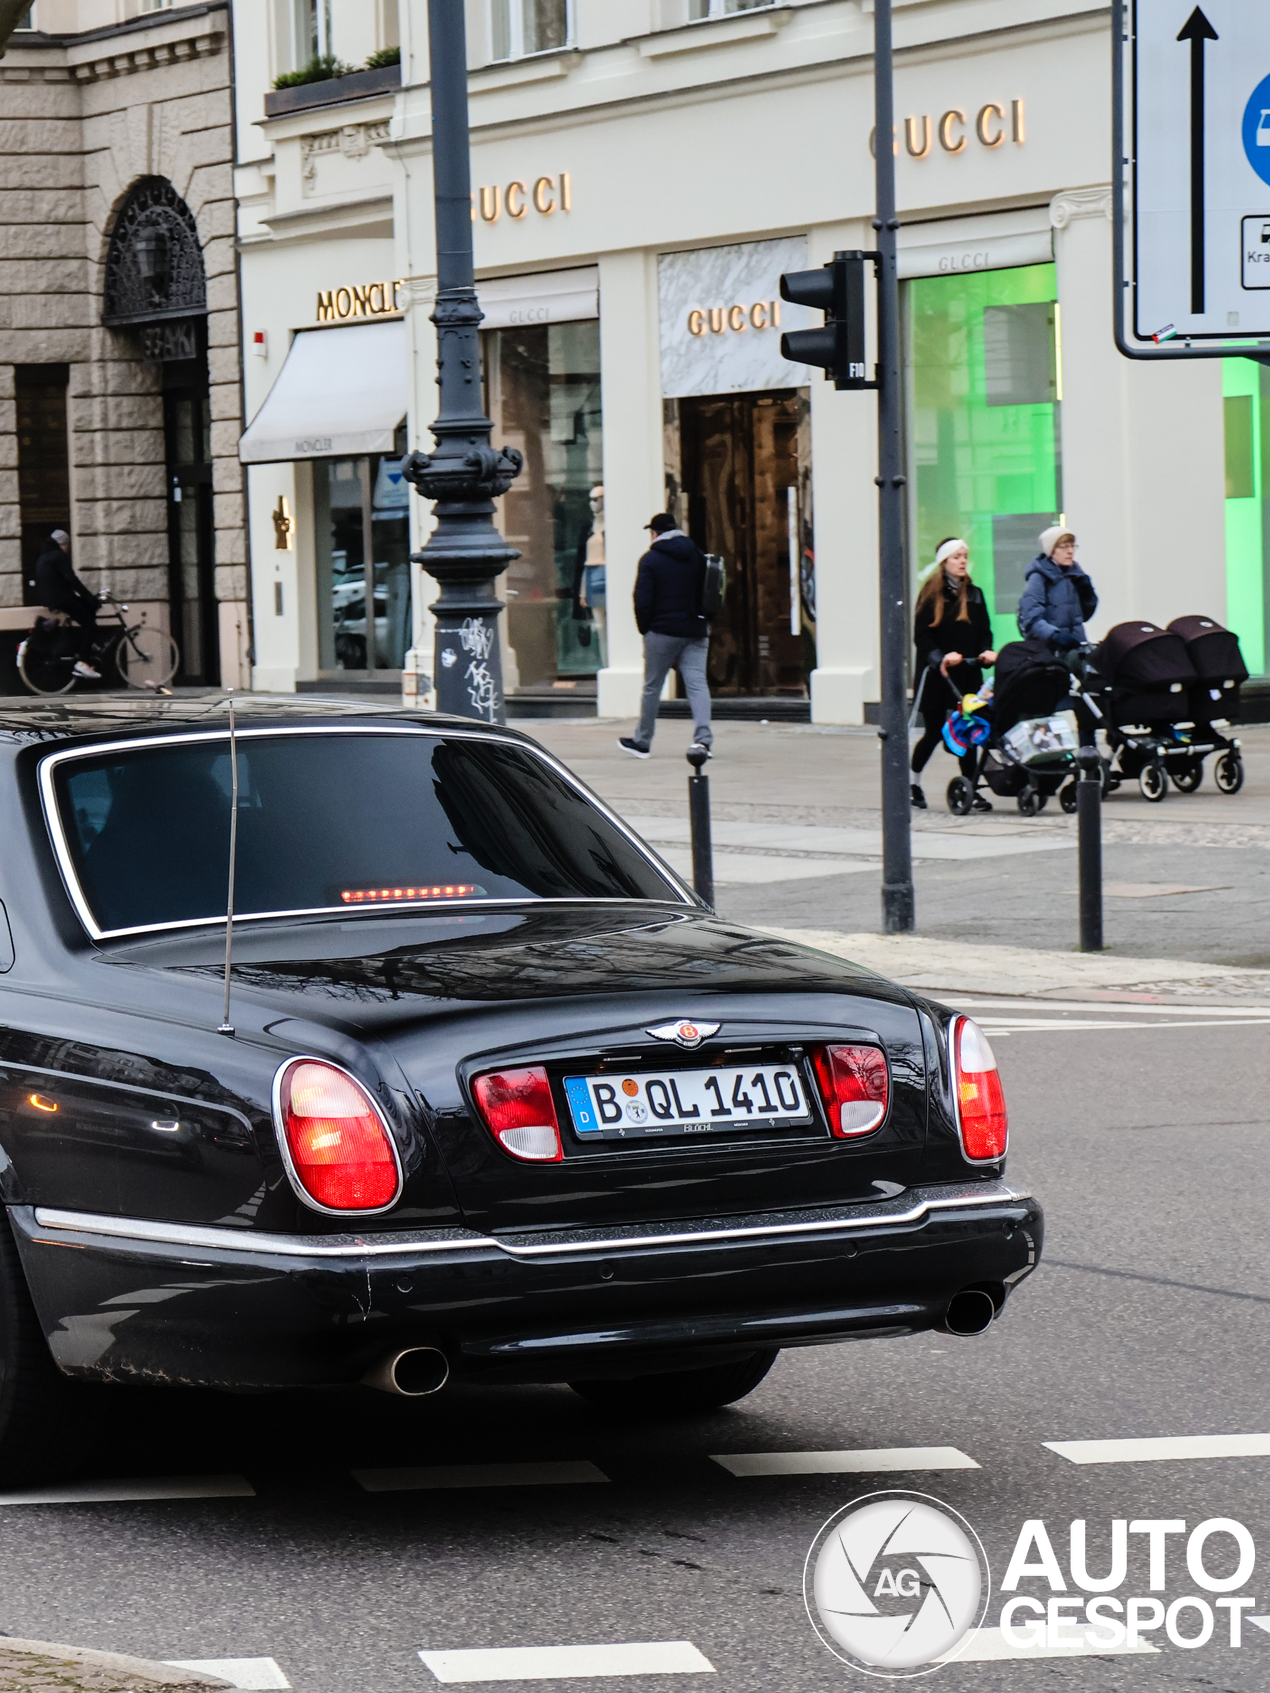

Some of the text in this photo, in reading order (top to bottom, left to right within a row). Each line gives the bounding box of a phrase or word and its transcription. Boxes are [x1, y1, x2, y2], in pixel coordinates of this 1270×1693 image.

[471, 172, 570, 222] UCCI
[939, 252, 989, 271] GUCCI
[510, 307, 549, 323] GUCCI
[687, 301, 780, 336] GUCCI
[580, 1111, 590, 1124] D
[593, 1083, 623, 1124] B
[645, 1078, 700, 1120] QL
[704, 1071, 801, 1117] 1410
